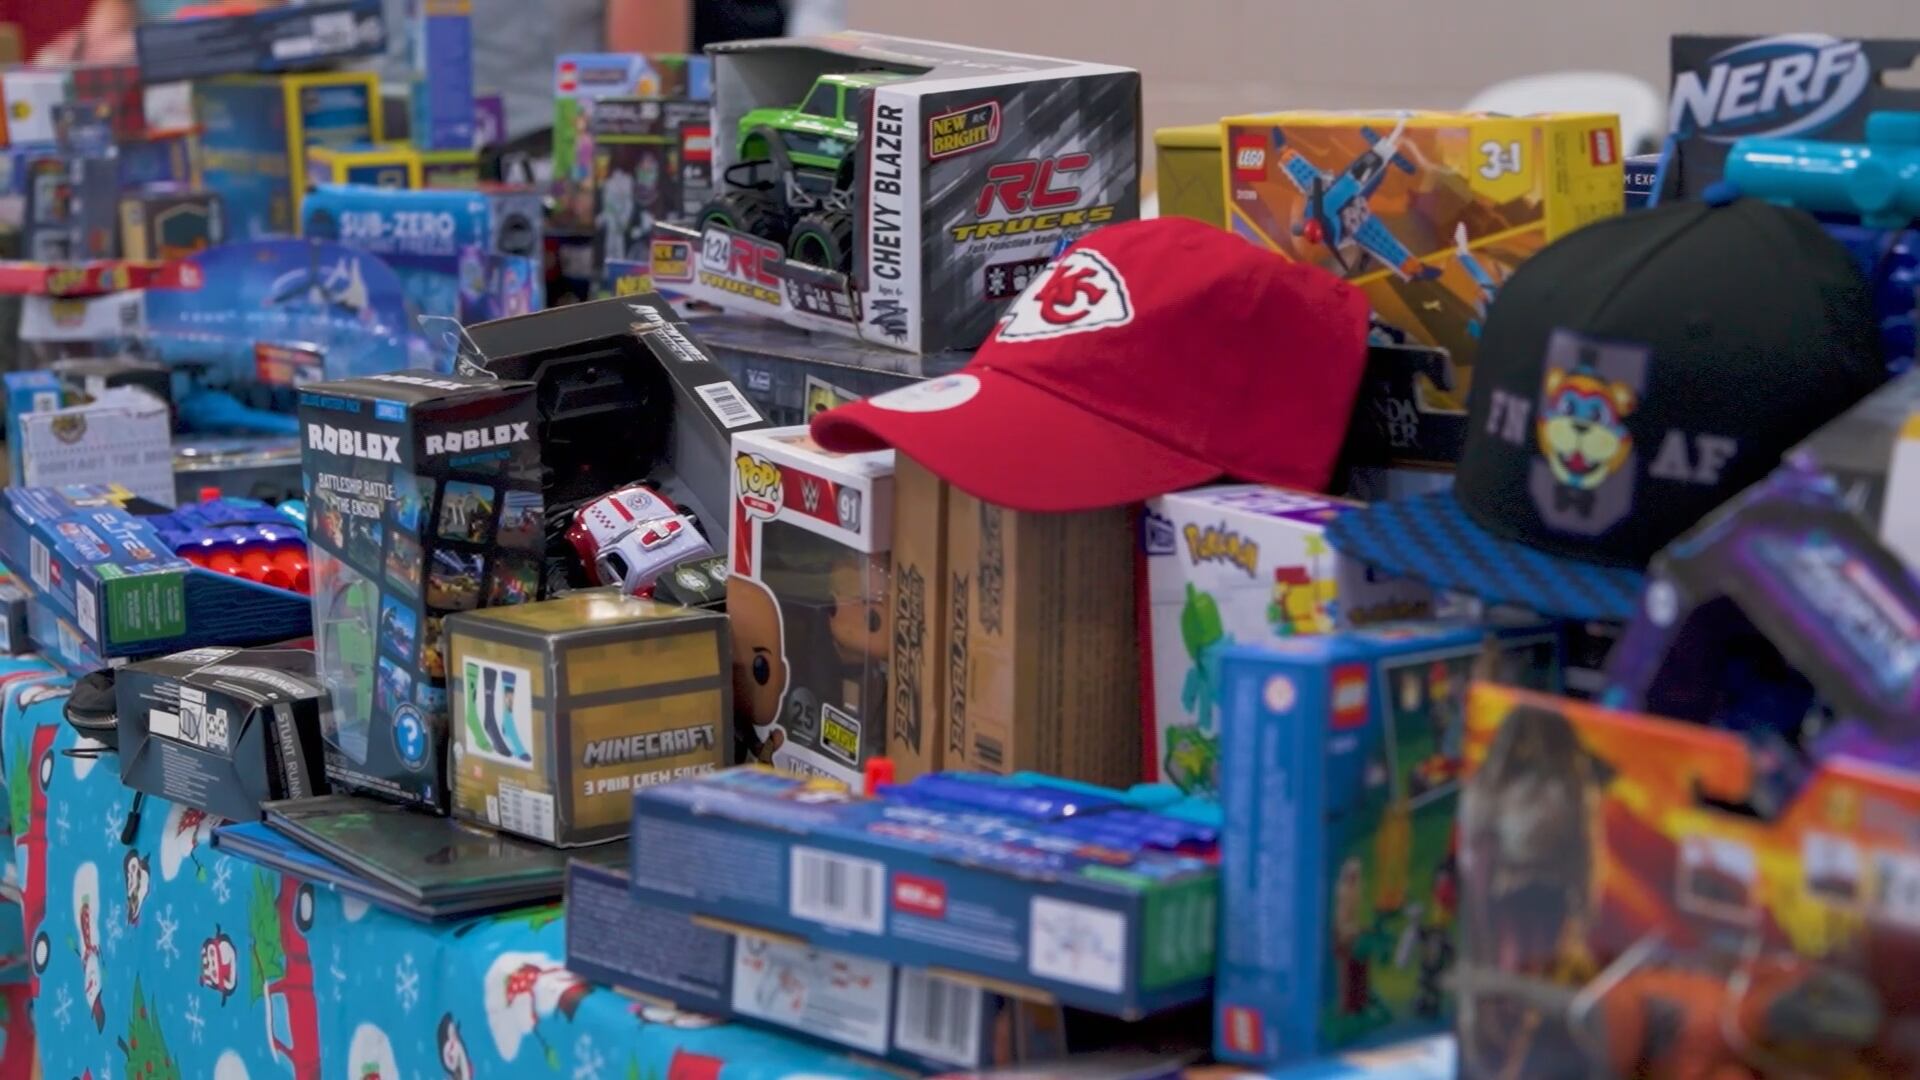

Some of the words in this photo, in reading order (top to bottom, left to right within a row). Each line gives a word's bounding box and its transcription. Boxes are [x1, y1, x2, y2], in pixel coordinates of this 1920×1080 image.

[1669, 42, 1861, 133] NERF
[934, 114, 966, 136] NEW
[934, 124, 988, 153] BRIGHT
[874, 104, 904, 196] BLAZER
[1237, 148, 1265, 169] LEGO
[975, 152, 1093, 218] RC
[340, 211, 454, 237] SUB-ZERO
[872, 203, 902, 281] CHEVY
[951, 205, 1116, 243] TRUCKS
[703, 236, 729, 266] 1:24
[729, 236, 782, 287] RC
[988, 238, 1032, 252] Function
[701, 273, 782, 306] TRUCKS
[307, 423, 402, 464] ROBLOX
[425, 421, 531, 456] ROBLOX
[1650, 429, 1738, 485] AF
[318, 472, 363, 492] BATTLESHIP
[735, 455, 782, 502] POP!
[351, 500, 380, 519] ENSIGN
[839, 493, 858, 525] 91
[894, 565, 912, 743] BEYBLADE
[952, 573, 968, 752] BEYBLADE
[277, 712, 296, 758] STUNT
[582, 724, 714, 767] MINECRAFT
[286, 760, 303, 800] RUNN
[583, 780, 593, 796] 3
[596, 776, 630, 794] PAIR
[632, 770, 672, 789] CREW
